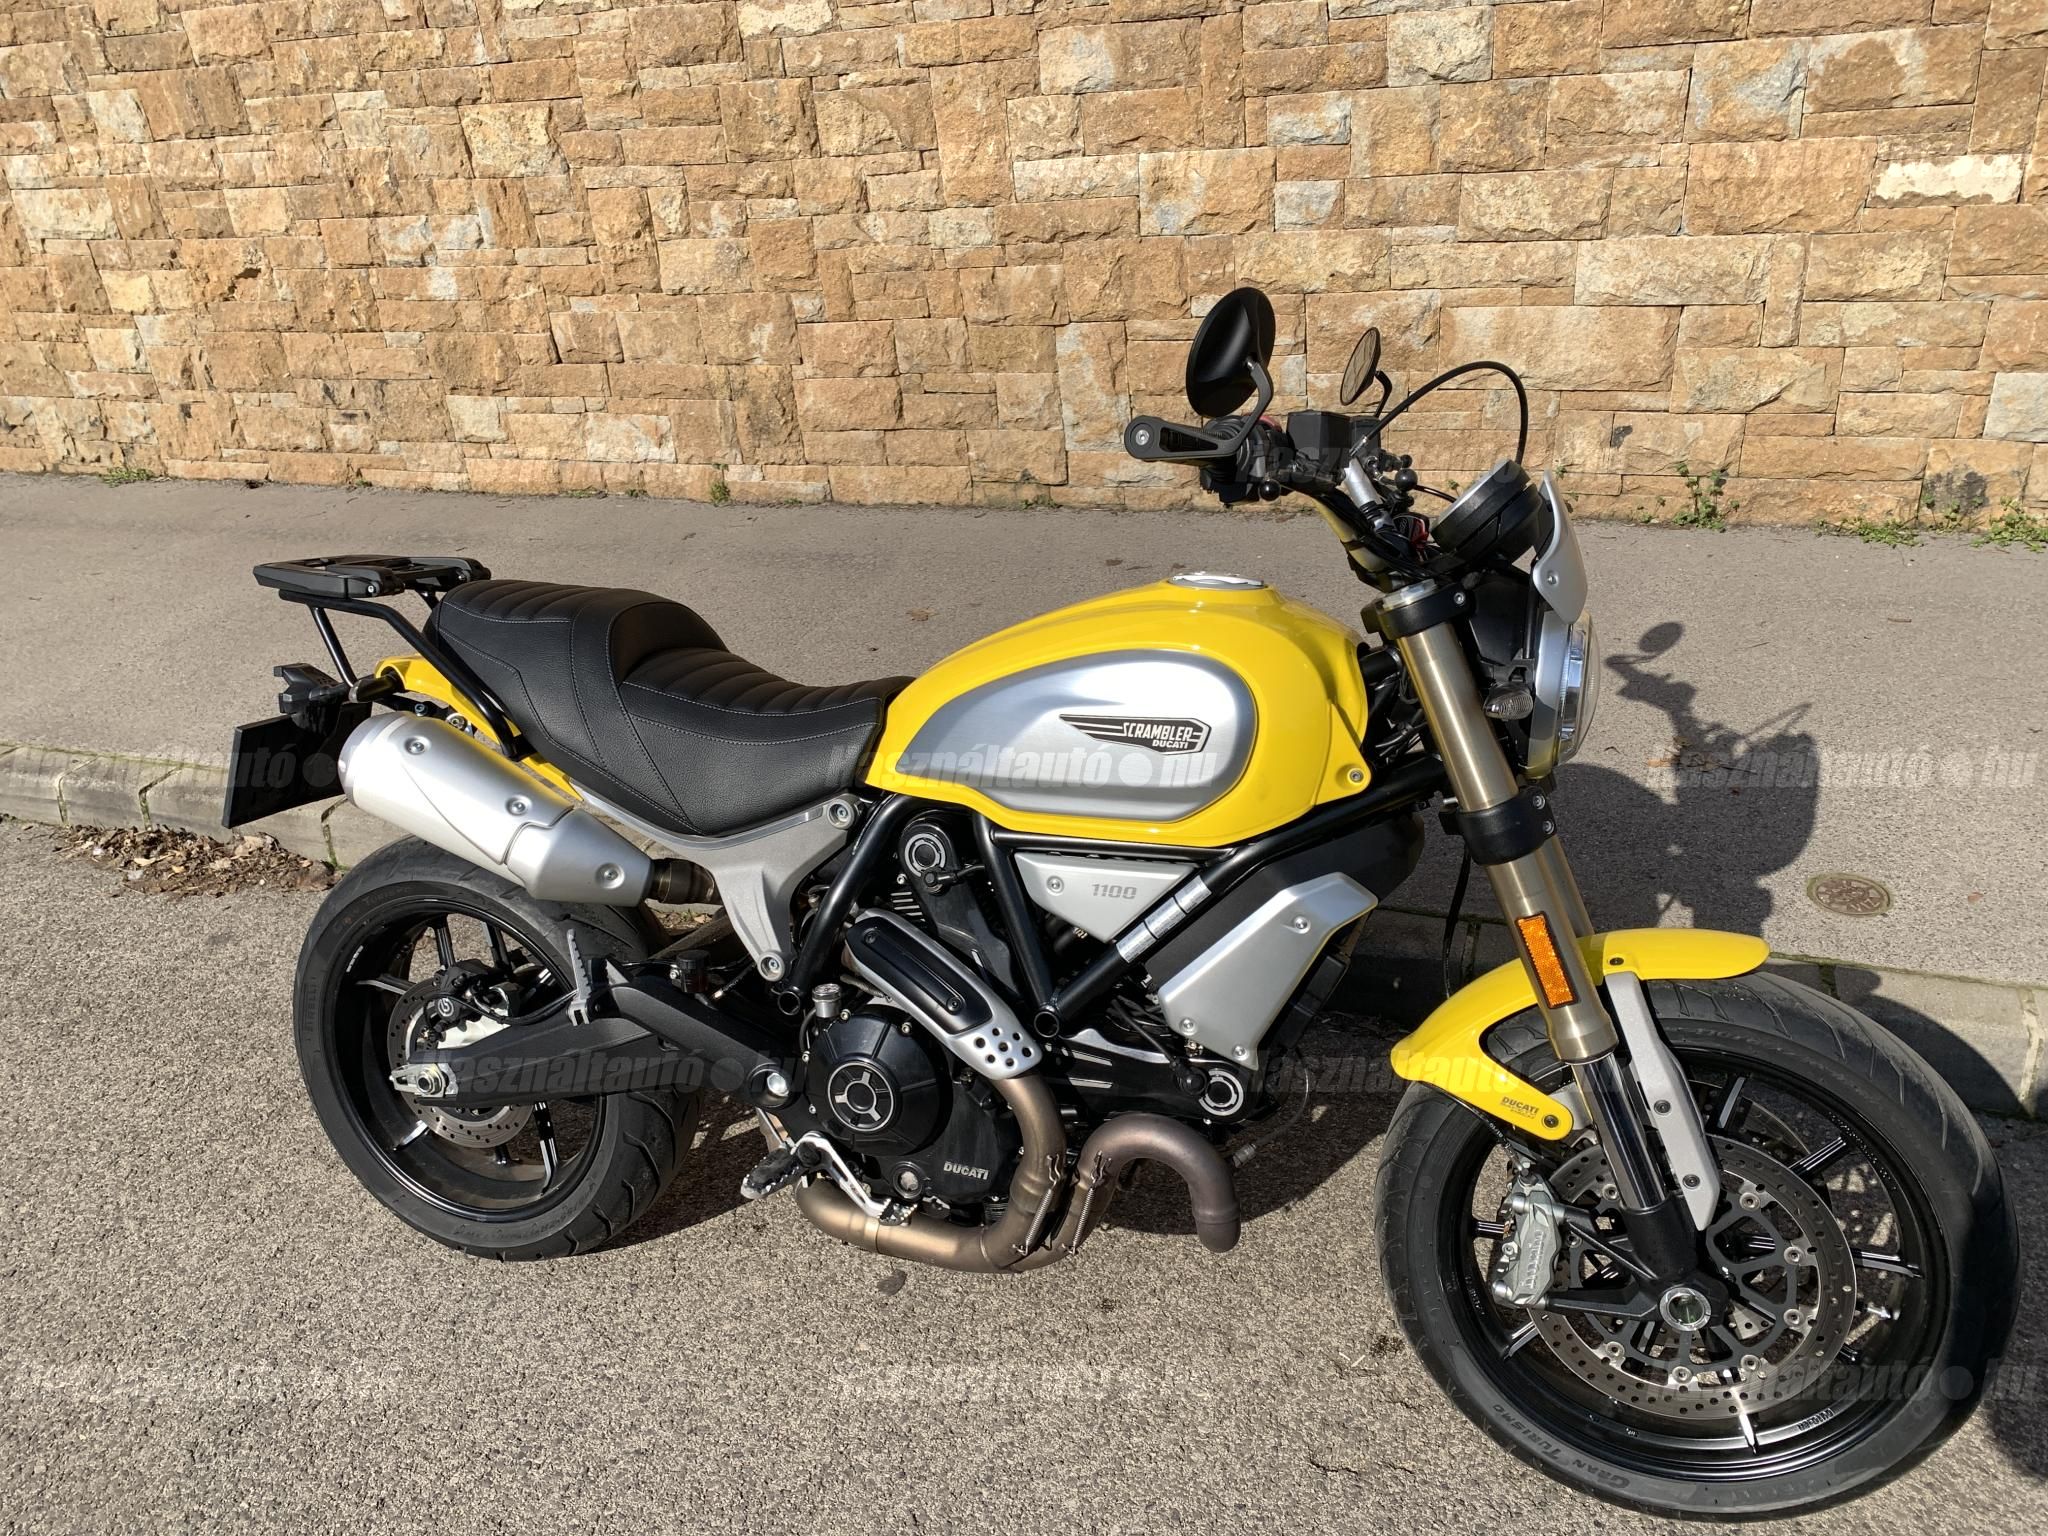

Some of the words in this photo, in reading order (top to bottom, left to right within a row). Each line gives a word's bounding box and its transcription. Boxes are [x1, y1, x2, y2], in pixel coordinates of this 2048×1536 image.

[1123, 721, 1194, 742] SCRAMBLER
[1152, 739, 1189, 750] DUCATI
[1091, 883, 1137, 900] 1100
[1502, 1096, 1540, 1115] DUCATI
[943, 1161, 989, 1180] DUCATI
[1492, 1403, 1562, 1461] TURISMO
